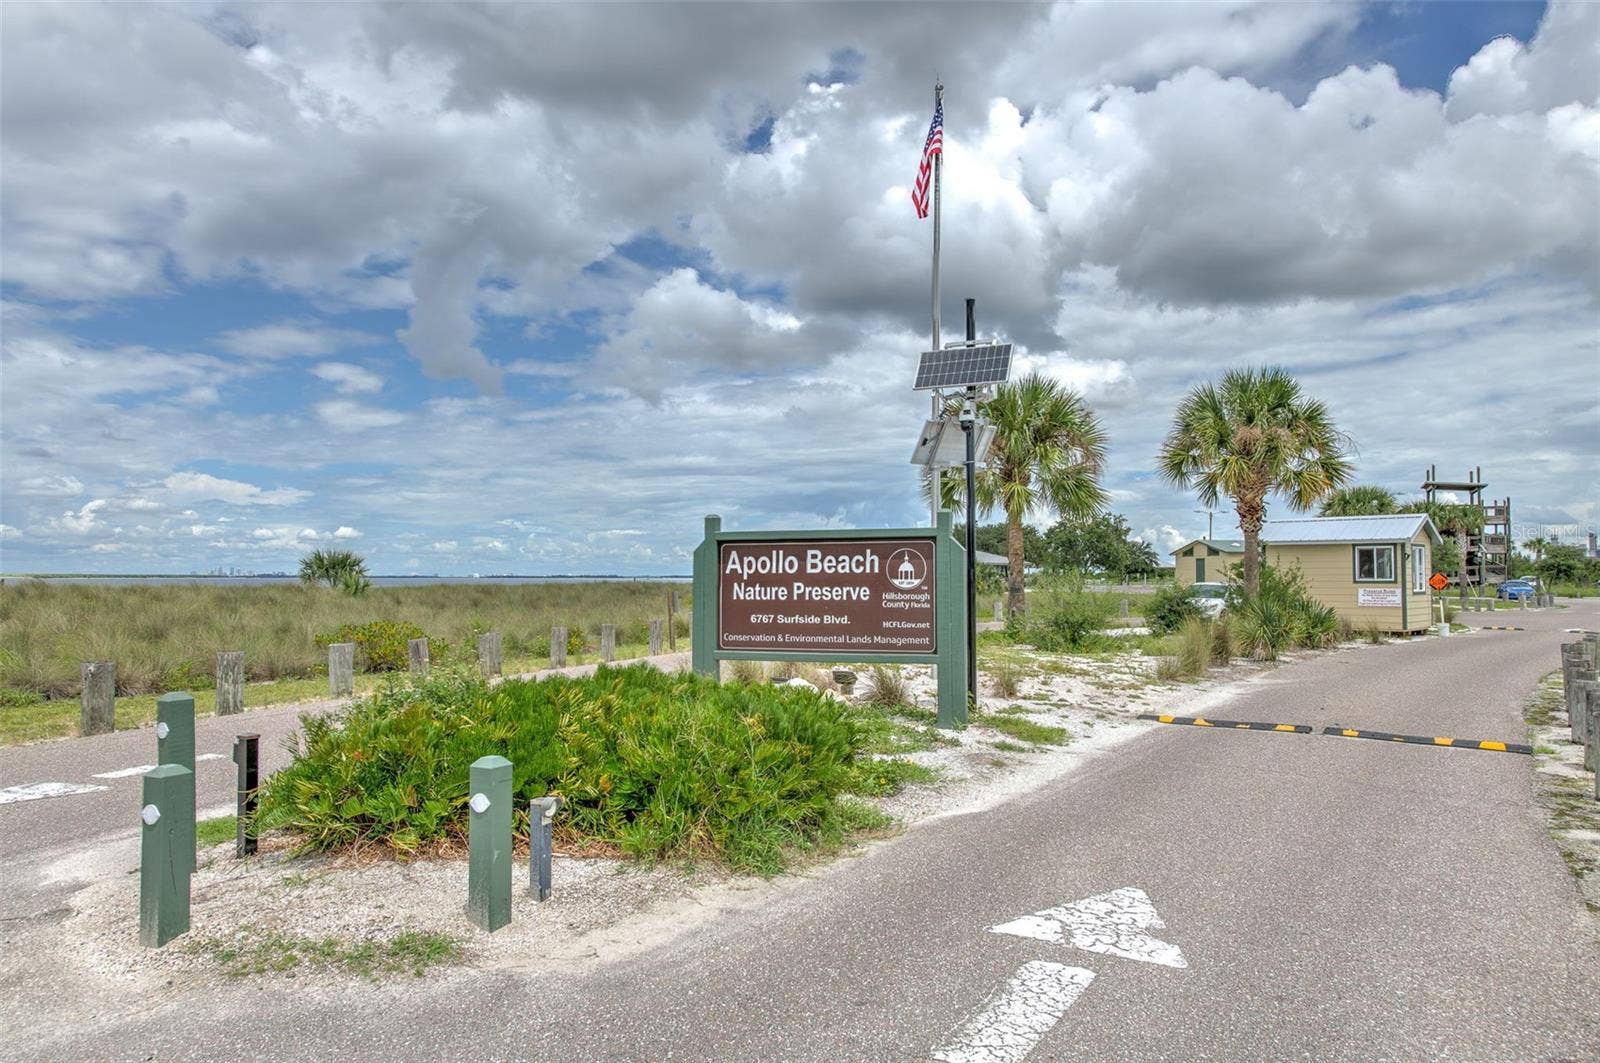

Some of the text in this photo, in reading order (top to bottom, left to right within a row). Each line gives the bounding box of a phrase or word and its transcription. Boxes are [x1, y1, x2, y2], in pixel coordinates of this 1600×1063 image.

[725, 549, 880, 580] Apollo Beach
[733, 582, 870, 601] Nature Preserve
[882, 592, 930, 601] Hillsborough
[882, 600, 910, 610] County
[750, 614, 851, 625] 6767 Surfside Blvd.
[882, 620, 930, 629] HCFLGov.net
[723, 632, 930, 647] Conservation & Environmental Lands Management
